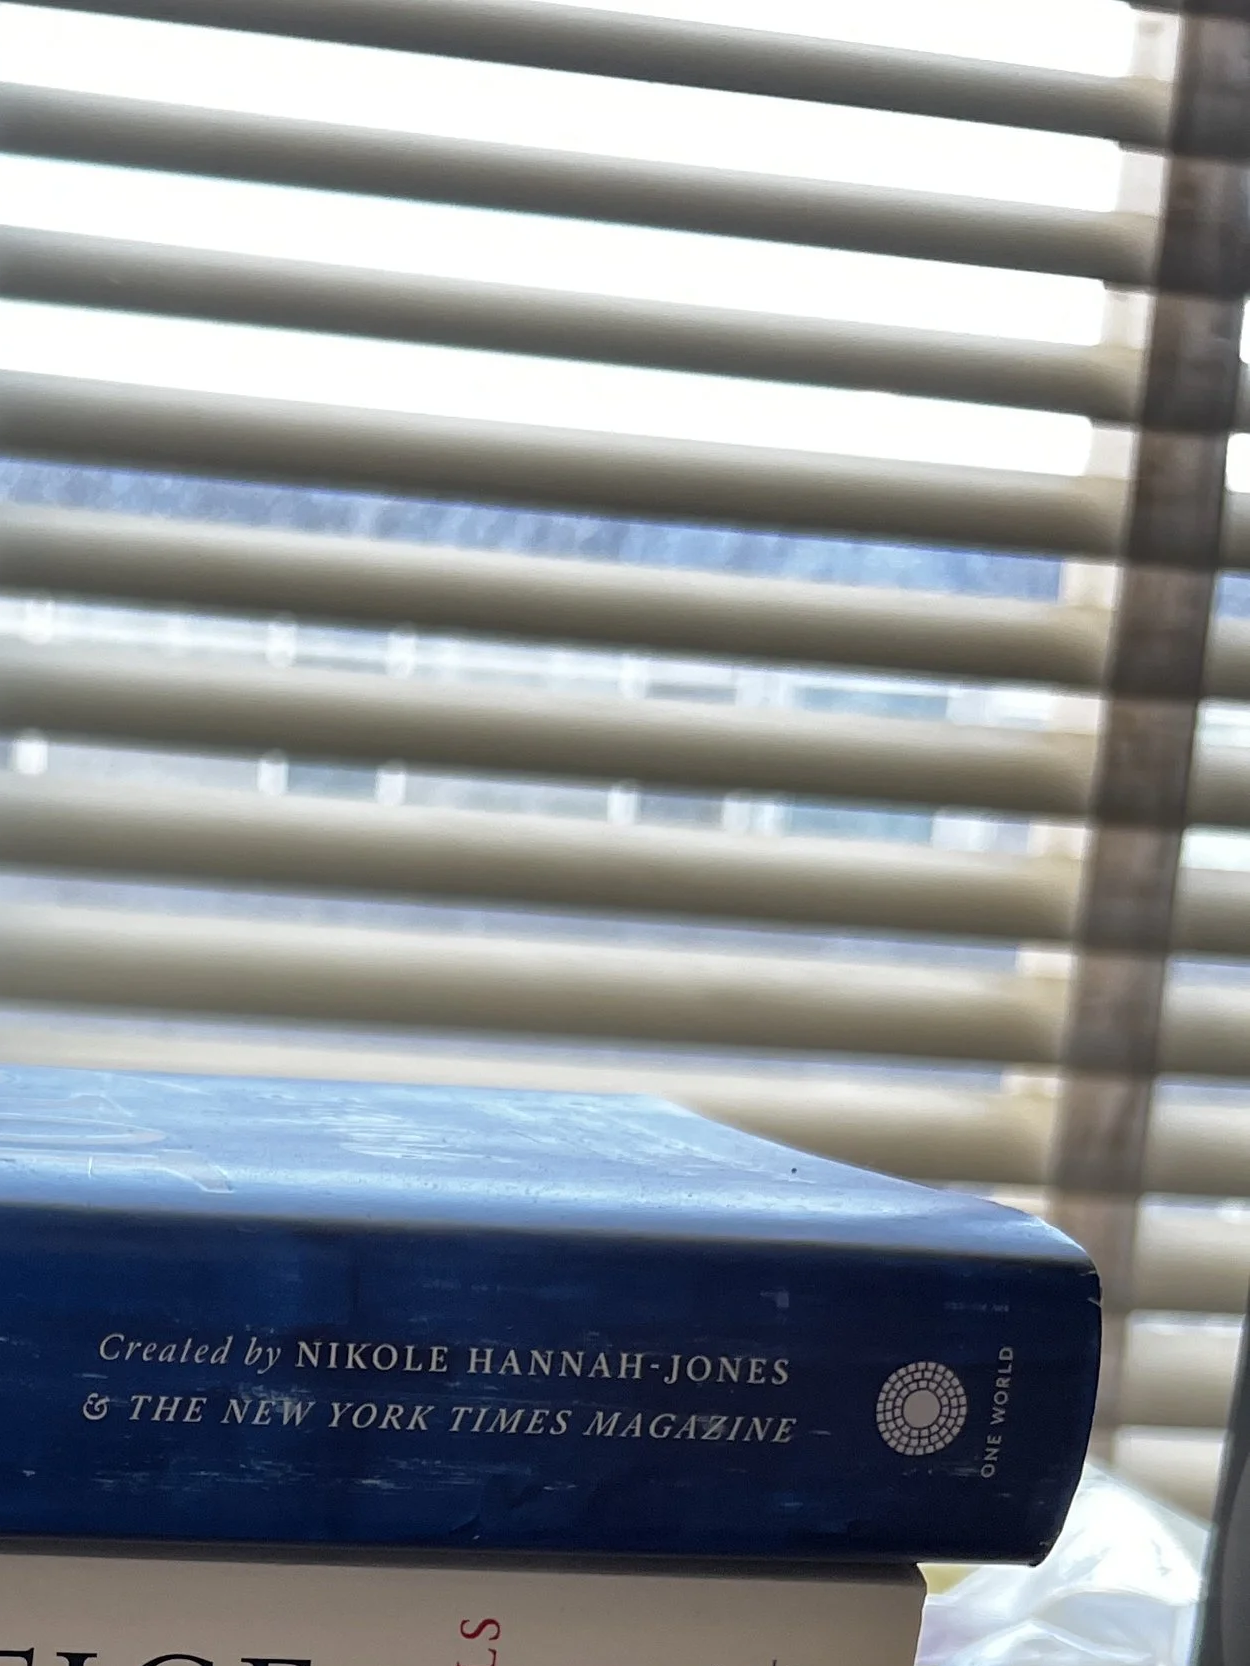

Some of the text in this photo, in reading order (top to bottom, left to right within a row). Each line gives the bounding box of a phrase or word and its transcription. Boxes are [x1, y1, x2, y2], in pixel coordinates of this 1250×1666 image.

[99, 1333, 791, 1386] Created by NIKOLE HANNAH-JONES
[82, 1392, 798, 1444] & THE NEW YORK TIMES MAGAZINE
[980, 1346, 1014, 1479] ONE WORLD
